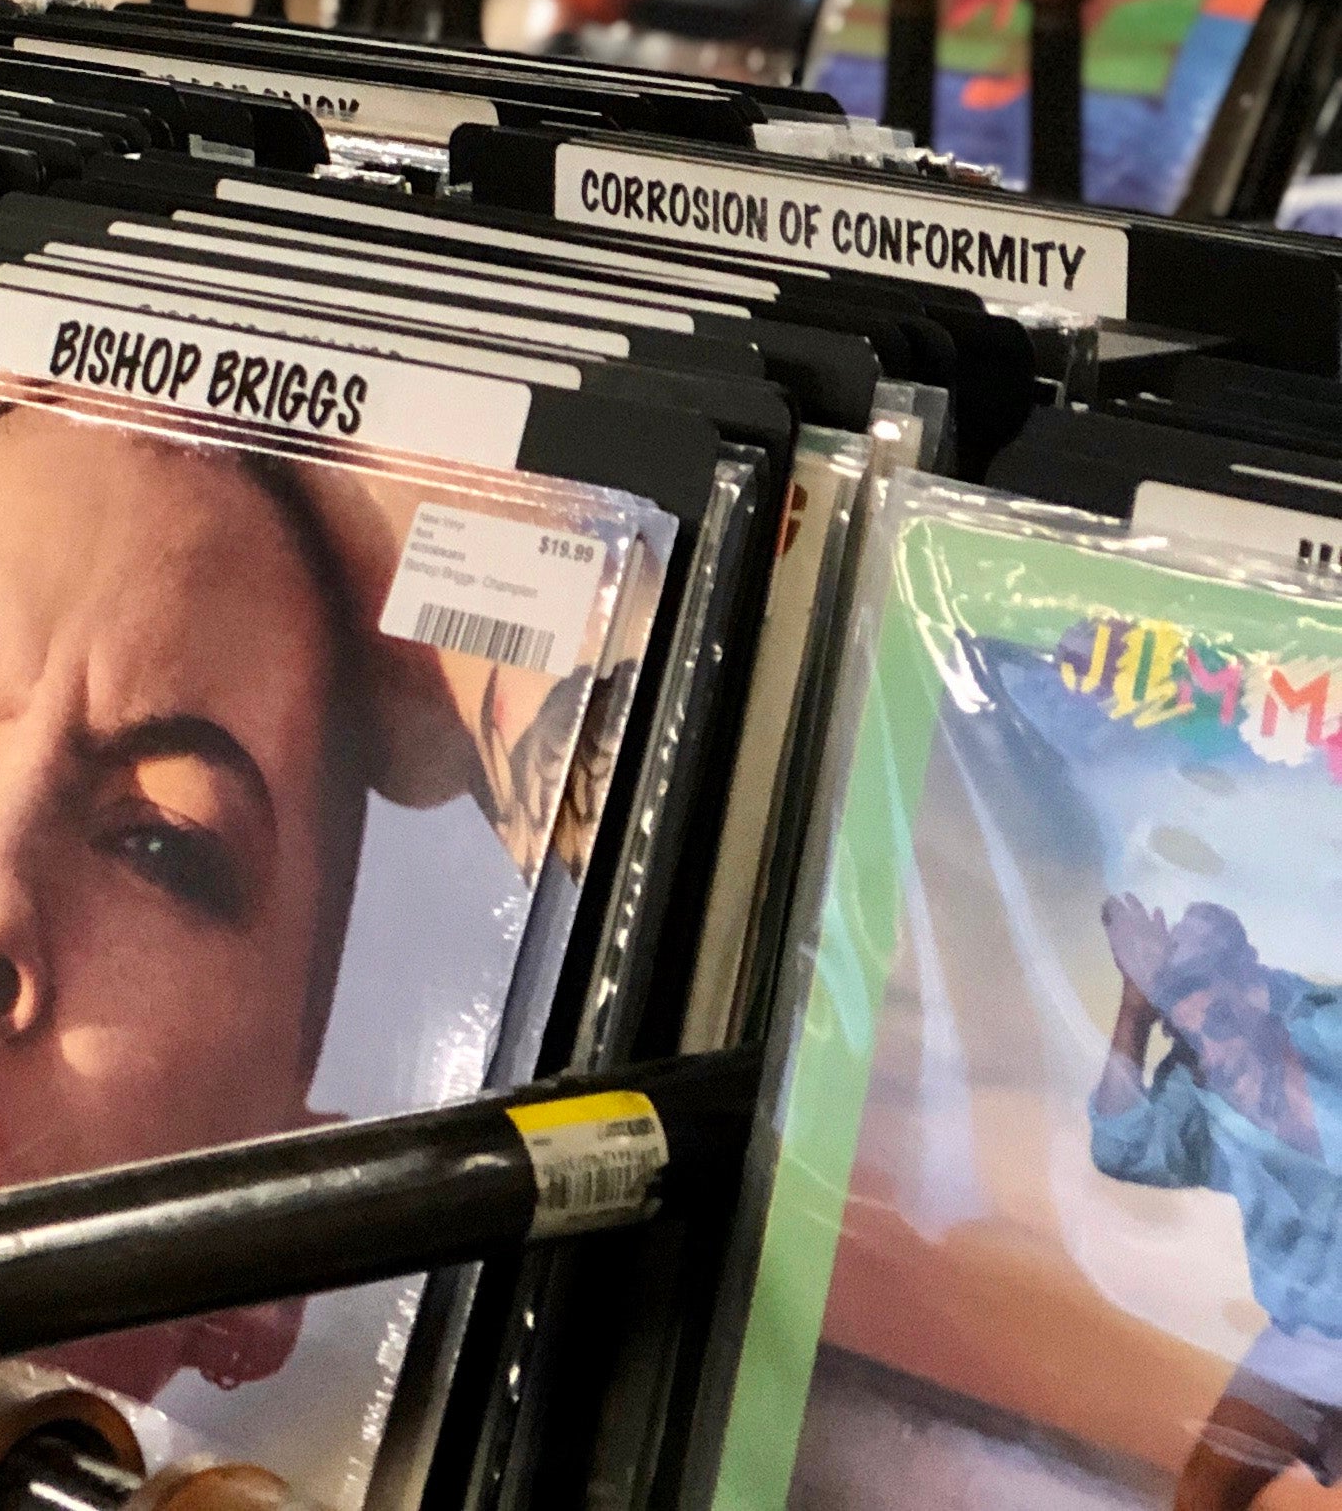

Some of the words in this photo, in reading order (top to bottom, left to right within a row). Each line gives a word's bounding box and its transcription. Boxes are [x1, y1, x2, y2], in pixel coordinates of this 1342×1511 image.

[581, 168, 768, 242] CORROSION
[778, 200, 822, 250] OF
[832, 208, 1087, 291] CONFORMITY
[48, 319, 203, 401] BISHOP
[206, 349, 369, 436] BRIGGS
[537, 535, 595, 564] $19.99
